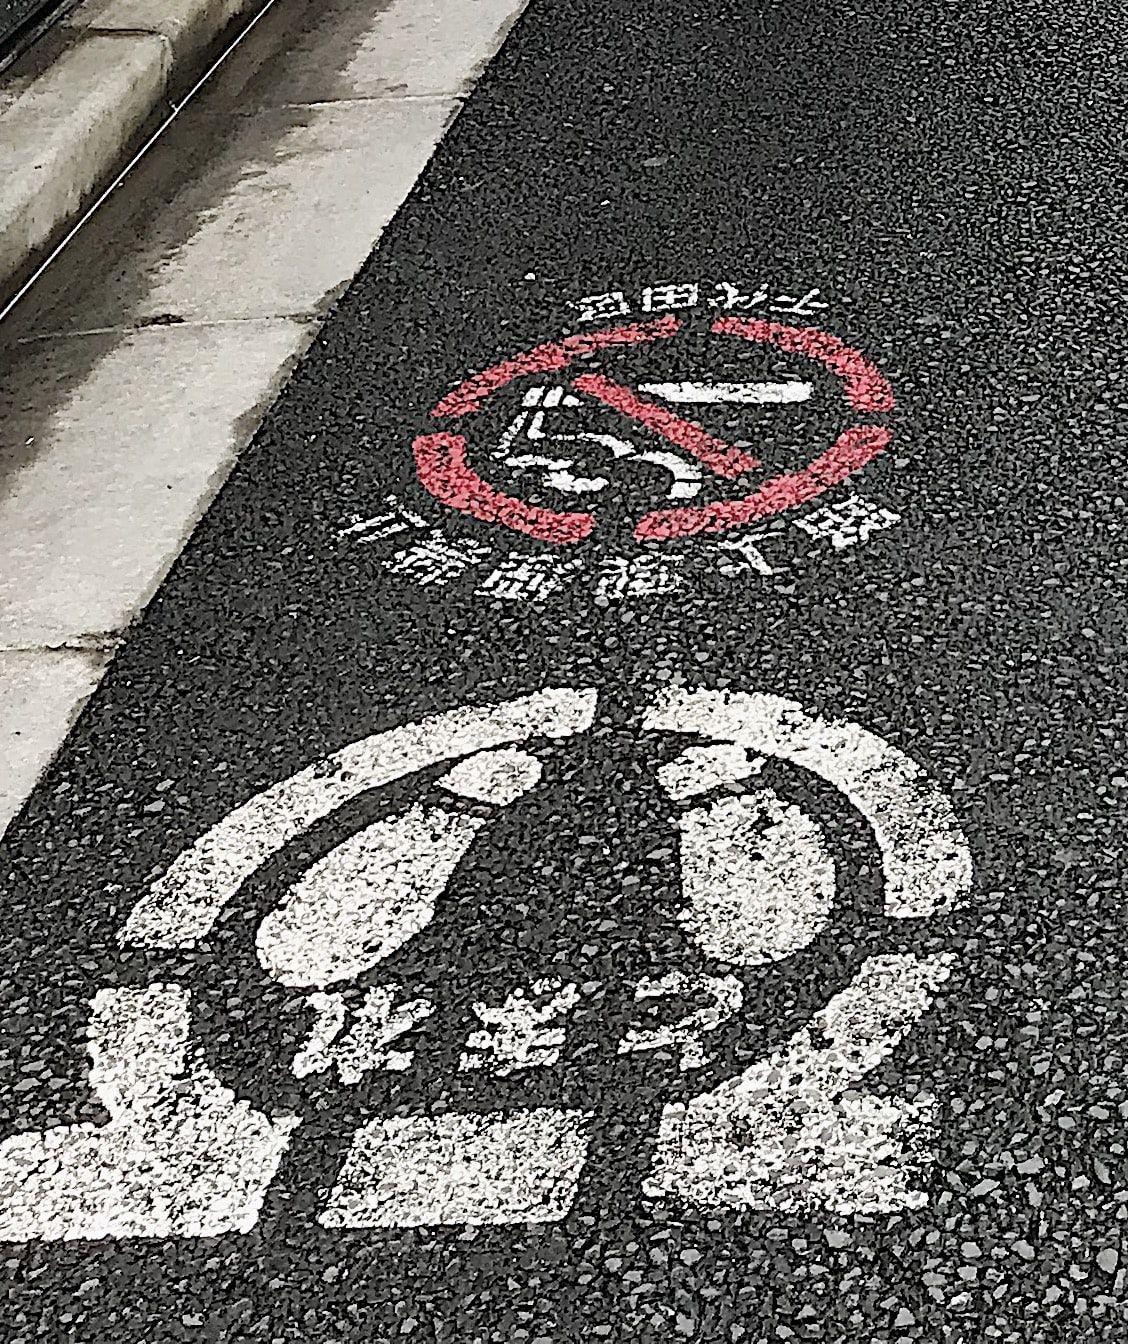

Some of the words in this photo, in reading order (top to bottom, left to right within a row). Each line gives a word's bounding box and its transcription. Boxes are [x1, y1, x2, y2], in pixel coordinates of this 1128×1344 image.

[565, 281, 830, 322] 千代田区
[289, 973, 746, 1086] とまれ
